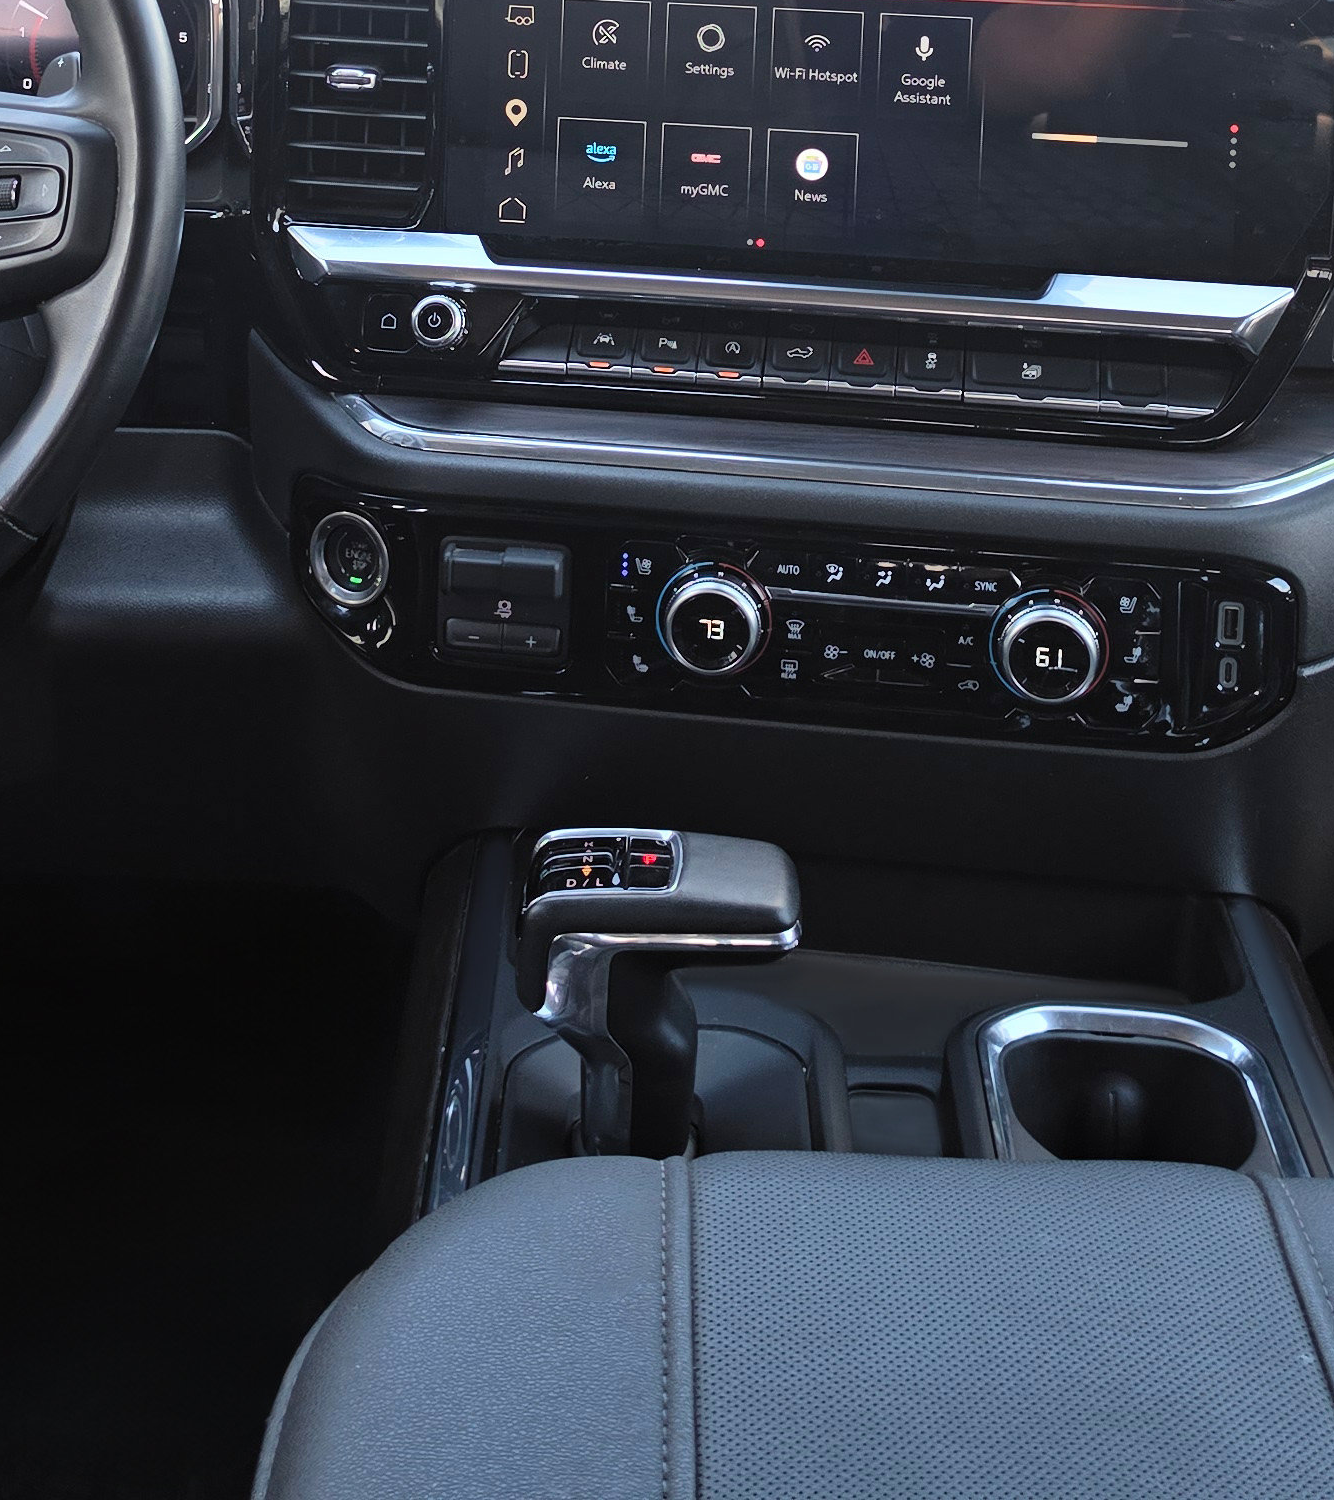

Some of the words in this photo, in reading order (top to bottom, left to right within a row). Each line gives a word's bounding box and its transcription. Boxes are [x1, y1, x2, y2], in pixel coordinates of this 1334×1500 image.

[178, 31, 188, 43] 5
[581, 56, 627, 72] Climate
[685, 62, 735, 79] Settings
[22, 77, 33, 90] 0
[774, 66, 805, 82] Wi-Fi
[808, 68, 859, 86] Hotspot
[900, 73, 947, 90] Google
[893, 91, 952, 107] Assistant
[585, 141, 617, 156] alexa
[582, 176, 617, 191] Alexa
[680, 183, 730, 199] myGMC
[794, 188, 829, 204] News
[776, 563, 800, 576] AUTO
[974, 579, 998, 593] SYNC
[698, 618, 725, 641] 73
[958, 635, 975, 647] A/C
[863, 648, 896, 661] ON/OFF
[1035, 646, 1064, 669] 61
